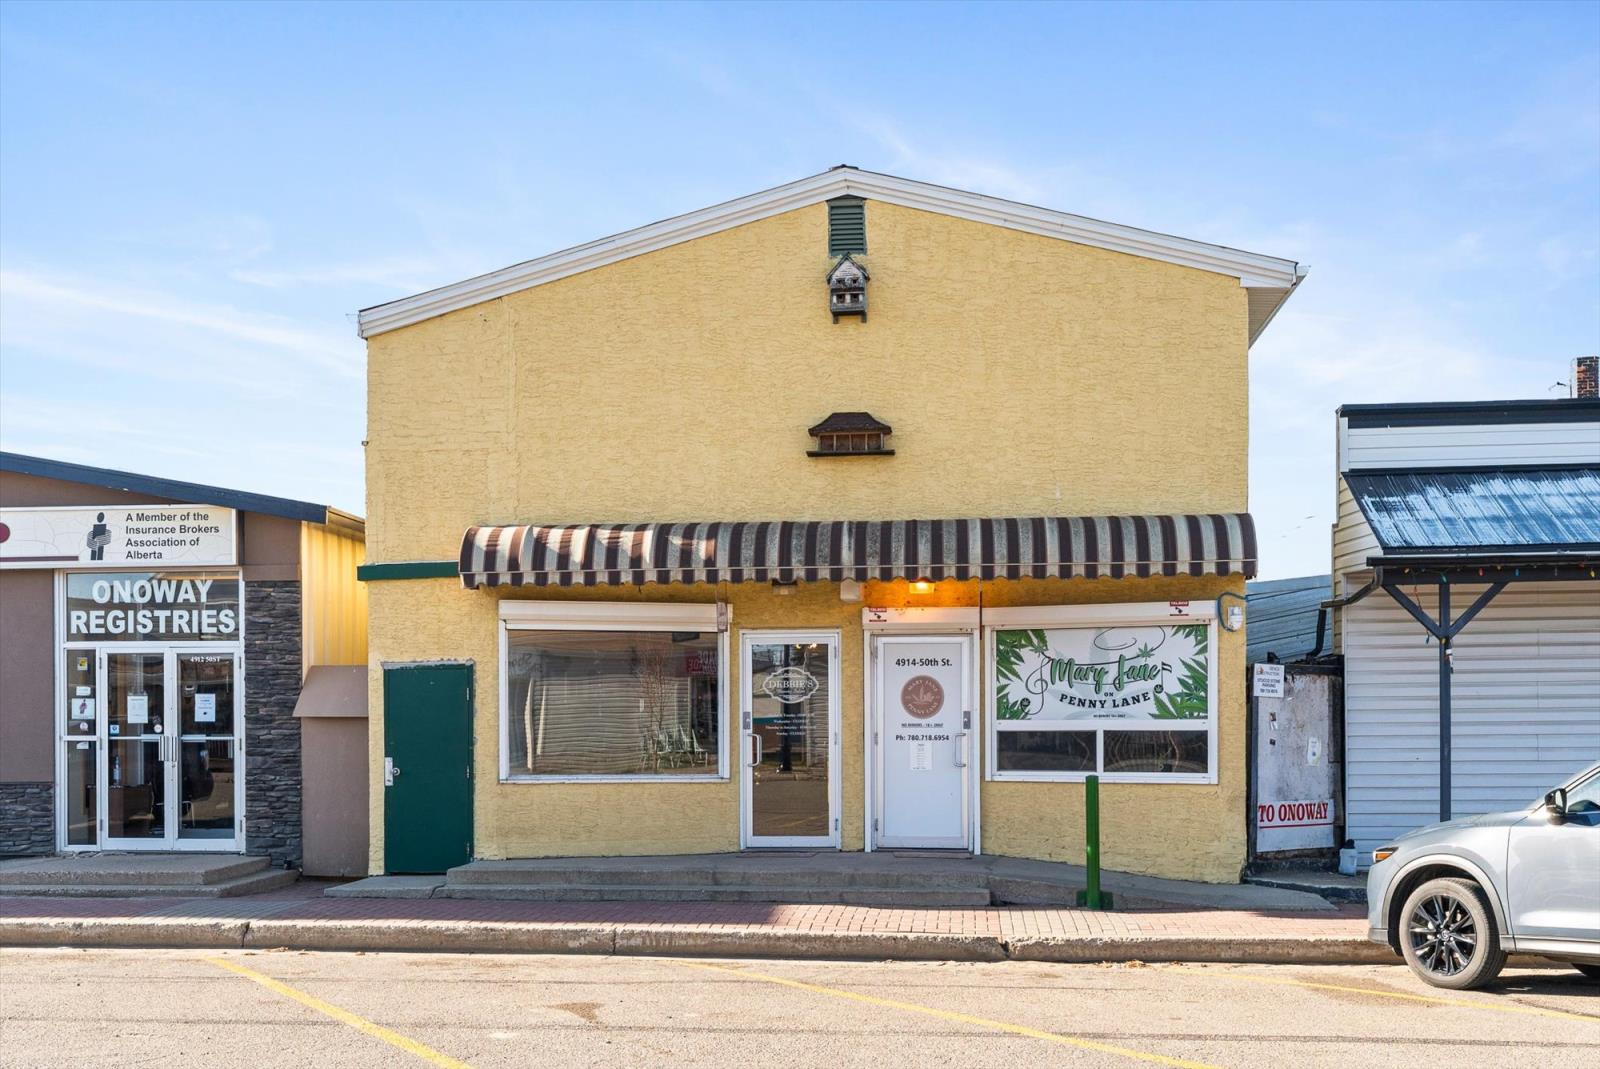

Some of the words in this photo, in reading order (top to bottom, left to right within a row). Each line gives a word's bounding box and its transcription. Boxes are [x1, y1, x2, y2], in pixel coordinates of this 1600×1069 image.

[126, 513, 134, 521] A
[136, 512, 177, 522] Member
[180, 512, 191, 521] of
[193, 512, 209, 521] the
[126, 525, 177, 535] Insurance
[179, 524, 220, 534] Brokers
[126, 537, 187, 547] Association
[189, 537, 200, 546] of
[126, 550, 163, 560] Alberta
[92, 579, 214, 604] ONOWAY
[70, 609, 236, 634] REGISTRIES
[896, 658, 939, 667] 4914-50th
[941, 658, 953, 667] St.
[1050, 658, 1109, 694] Mary
[1113, 654, 1161, 692] Jane
[1059, 693, 1107, 708] PENNY
[1113, 692, 1151, 708] LANE
[1258, 804, 1275, 823] TO
[1279, 802, 1329, 822] ONOWAY
